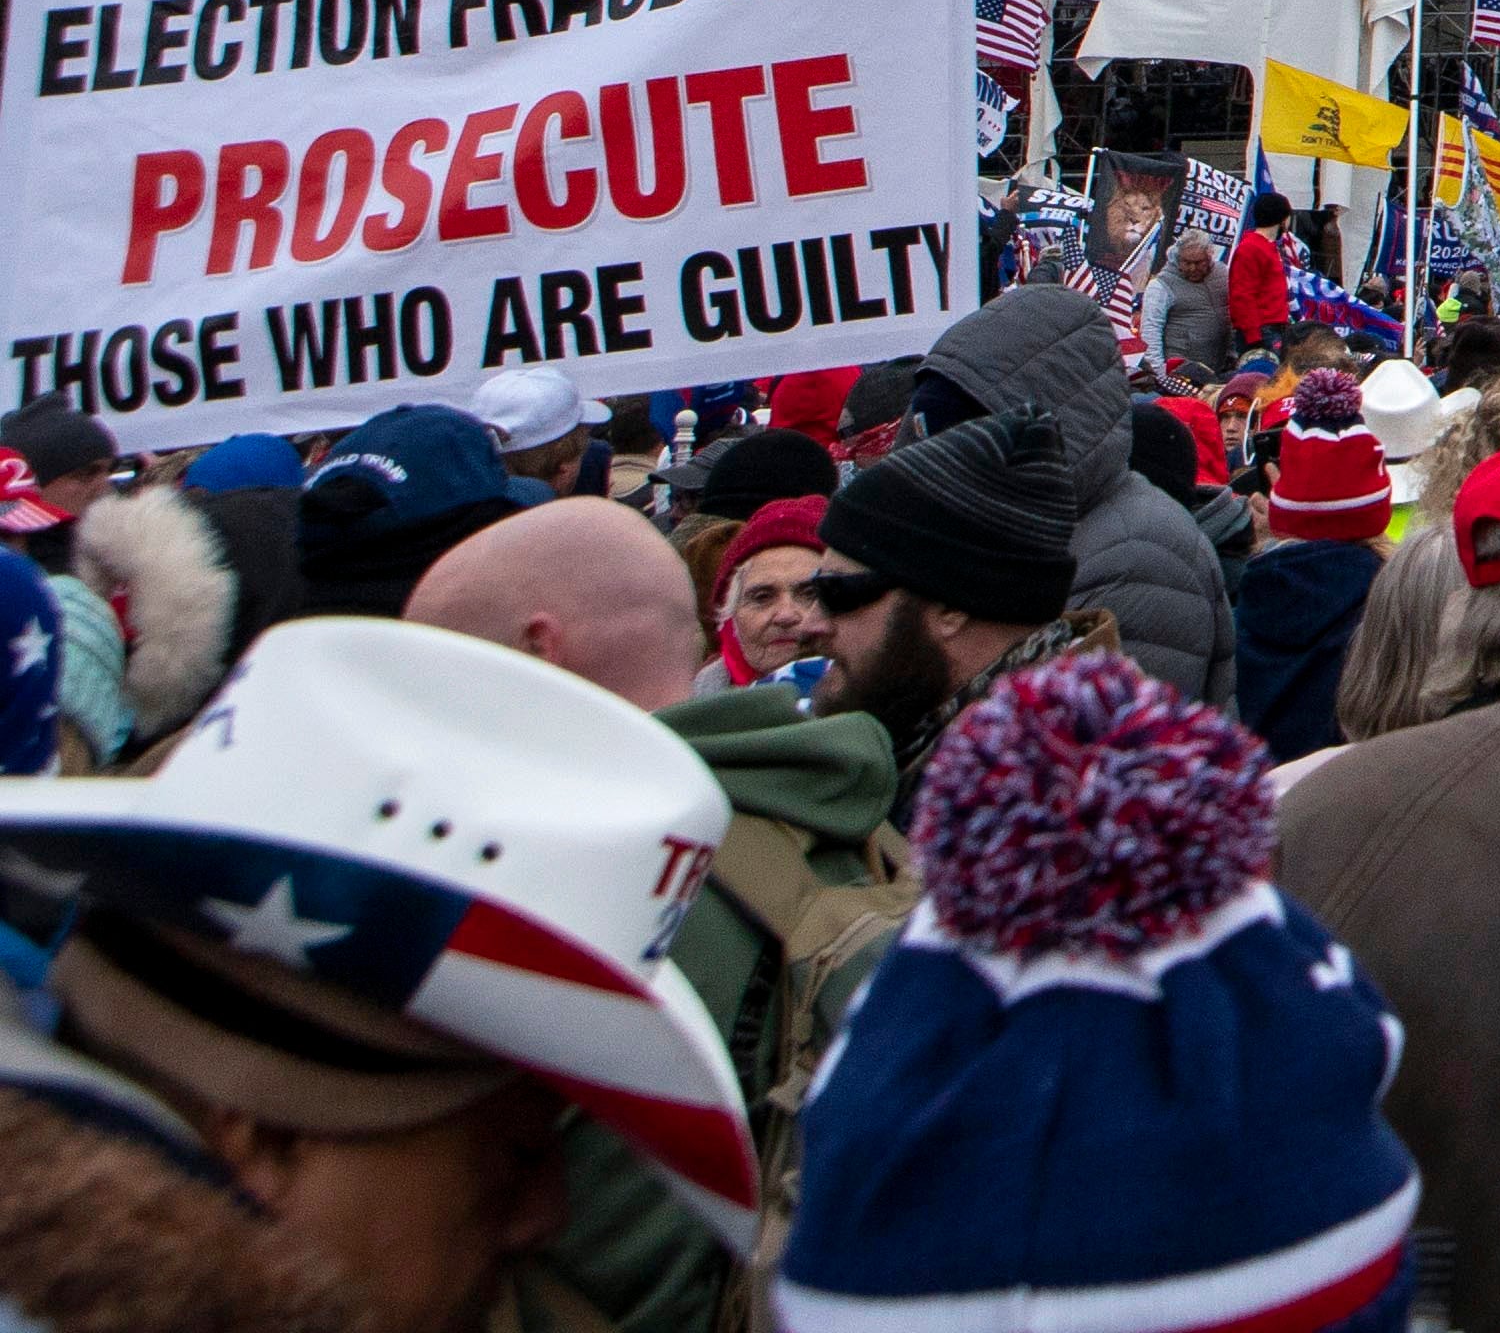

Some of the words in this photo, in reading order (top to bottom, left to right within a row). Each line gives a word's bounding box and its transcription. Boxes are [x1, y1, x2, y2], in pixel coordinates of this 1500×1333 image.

[121, 54, 869, 286] PROSECUTE
[1187, 157, 1251, 200] JESUS
[1199, 183, 1217, 201] MY
[12, 312, 247, 415] THOSE
[267, 287, 453, 393] WHO
[482, 261, 653, 370] ARE
[678, 222, 952, 341] GUILTY
[360, 453, 408, 485] TRUMP
